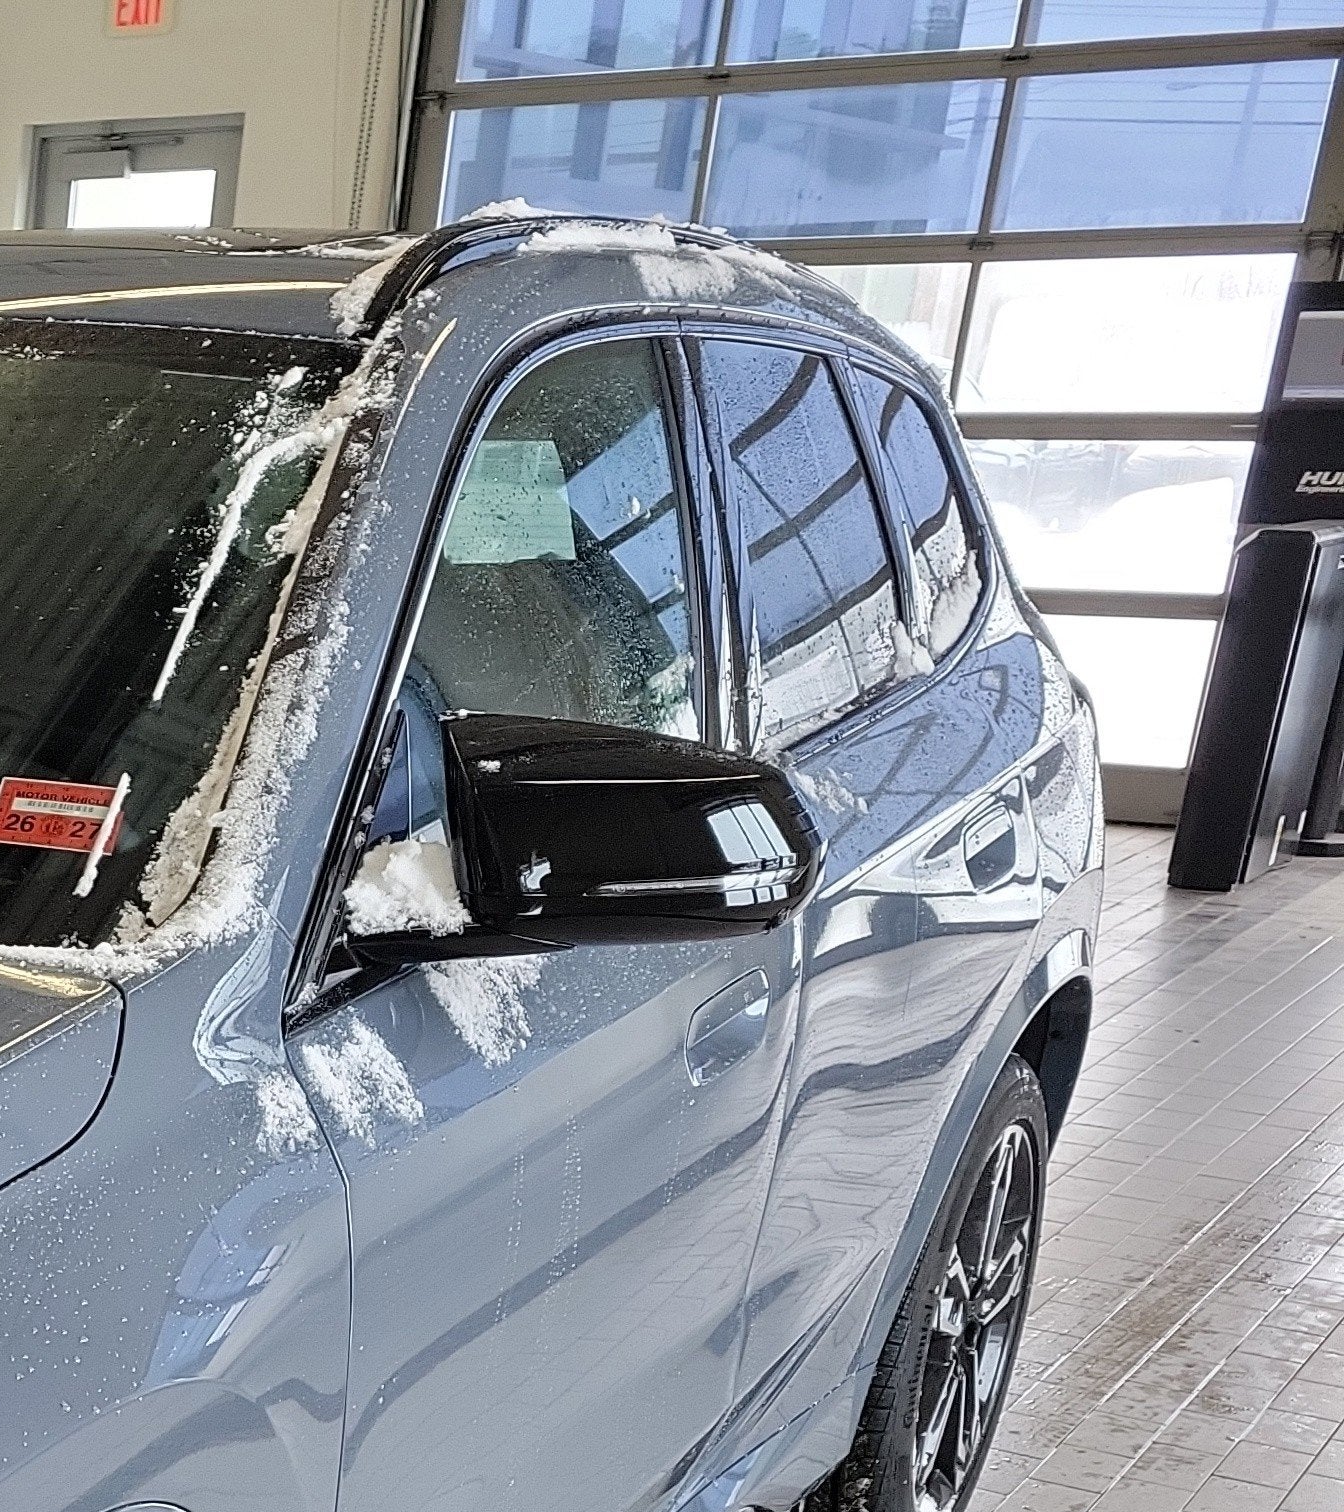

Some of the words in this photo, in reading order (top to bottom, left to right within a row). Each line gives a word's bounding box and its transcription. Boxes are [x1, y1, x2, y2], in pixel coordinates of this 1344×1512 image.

[1300, 471, 1344, 486] HU
[15, 790, 58, 801] MOTOR
[3, 813, 37, 833] 26
[68, 820, 104, 840] 27
